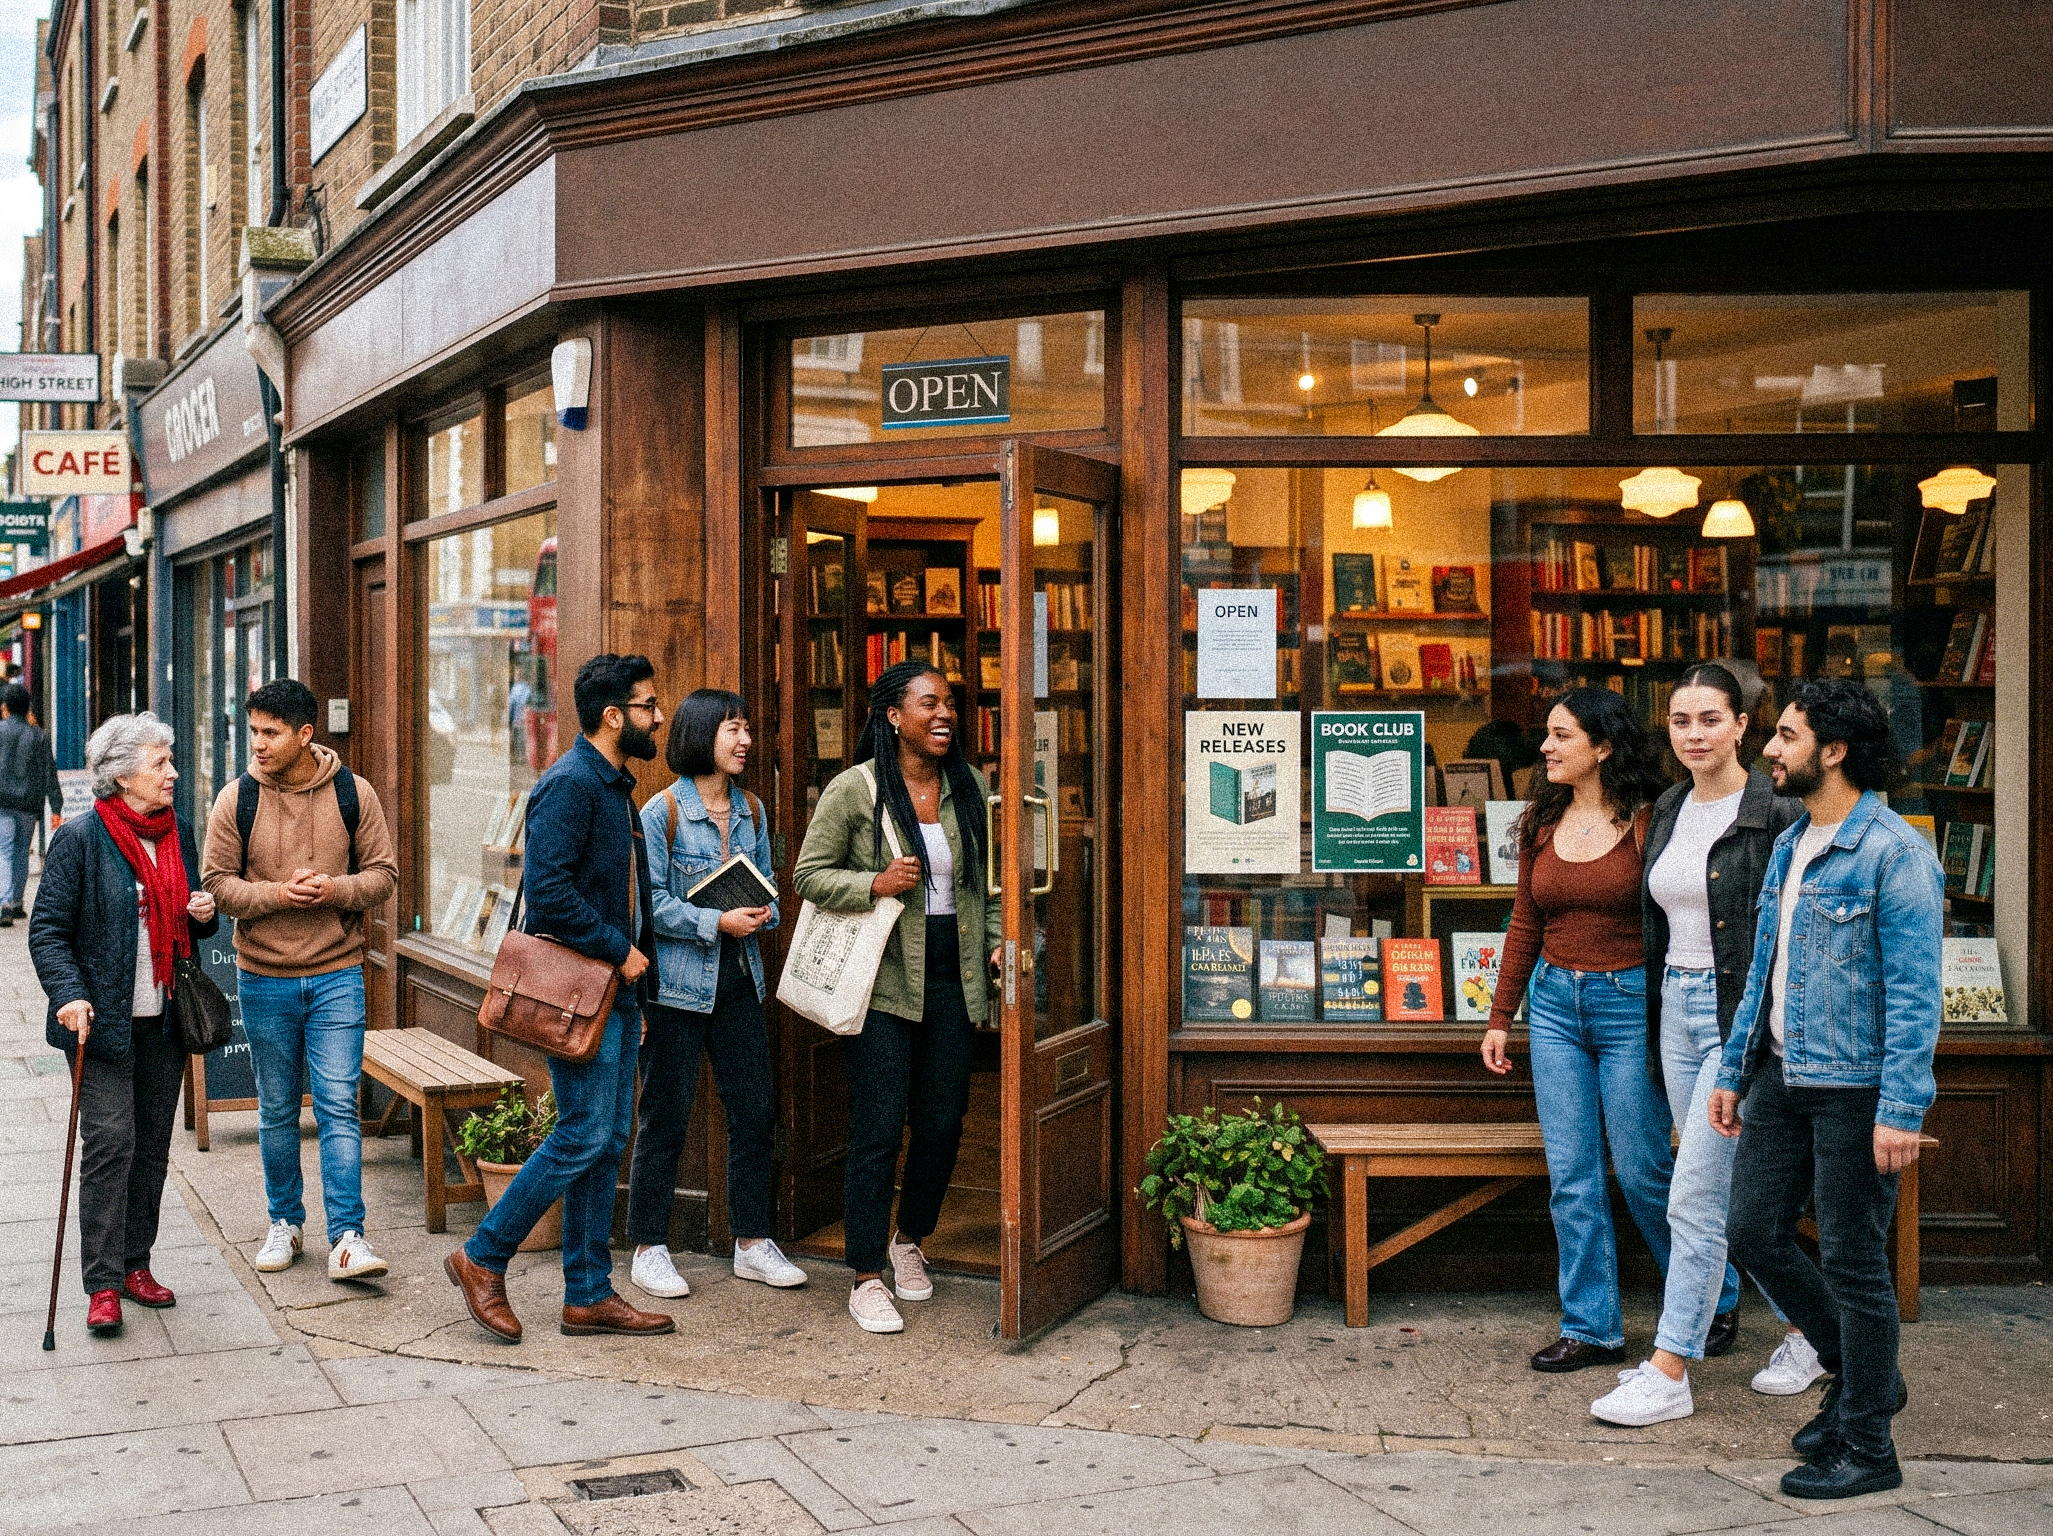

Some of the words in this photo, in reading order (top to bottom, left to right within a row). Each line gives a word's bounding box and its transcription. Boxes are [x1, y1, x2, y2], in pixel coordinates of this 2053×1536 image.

[38, 377, 94, 390] STREET
[889, 371, 1002, 414] OPEN
[32, 444, 120, 476] CAFÉ
[1215, 605, 1258, 618] OPEN
[1222, 723, 1264, 736] NEW
[1321, 723, 1369, 737] BOOK
[1372, 723, 1414, 737] CLUB
[1200, 740, 1286, 754] RELEASES
